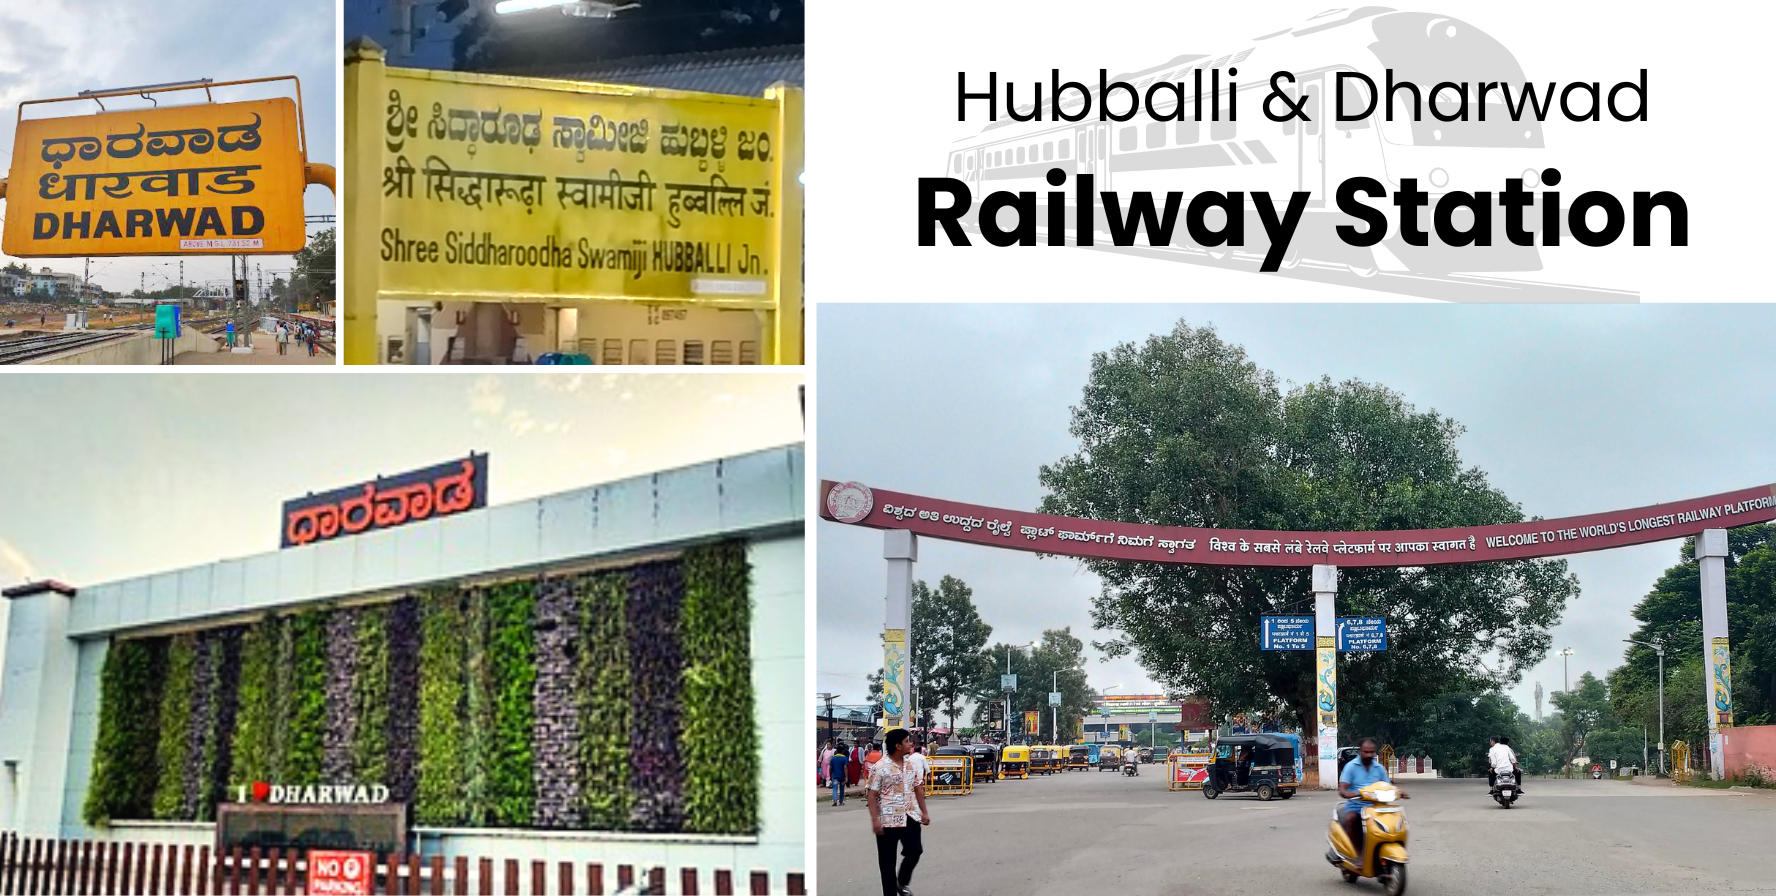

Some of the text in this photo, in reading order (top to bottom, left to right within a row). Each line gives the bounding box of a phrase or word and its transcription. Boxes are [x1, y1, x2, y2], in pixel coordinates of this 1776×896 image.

[41, 112, 262, 169] ಧಾರವಾಡ
[386, 89, 418, 153] ಶ್ರೀ
[553, 114, 649, 163] ಸ್ವಾಮೀಜಿ
[39, 164, 262, 201] धारवाड
[382, 155, 416, 199] श्री
[555, 168, 657, 212] स्वामीजी
[33, 206, 265, 240] DHARWAD
[381, 227, 768, 279] Shree Siddharoodha Swamiji HUBBALLI Jn.
[287, 460, 475, 545] ಧಾರವಾಡ
[1486, 496, 1776, 548] WELCOME TO THE WORLD'S LONGEST RAILWAY PLATFORM
[883, 503, 917, 521] ವಿಶ್ವದ
[919, 509, 940, 522] ಅತಿ
[943, 514, 984, 532] ಉದ್ದದ
[1020, 524, 1055, 540] ಪ್ಲಾಟ್
[1117, 534, 1154, 547] ನಿಮಗೆ
[1158, 538, 1197, 554] ಸ್ವಾಗತ
[1209, 535, 1476, 554] विश्व के सबसे लंबे रेलवे प्लेटफार्म पर आपका स्वागत है
[236, 784, 390, 804] I DHARWAD
[317, 858, 339, 876] NO
